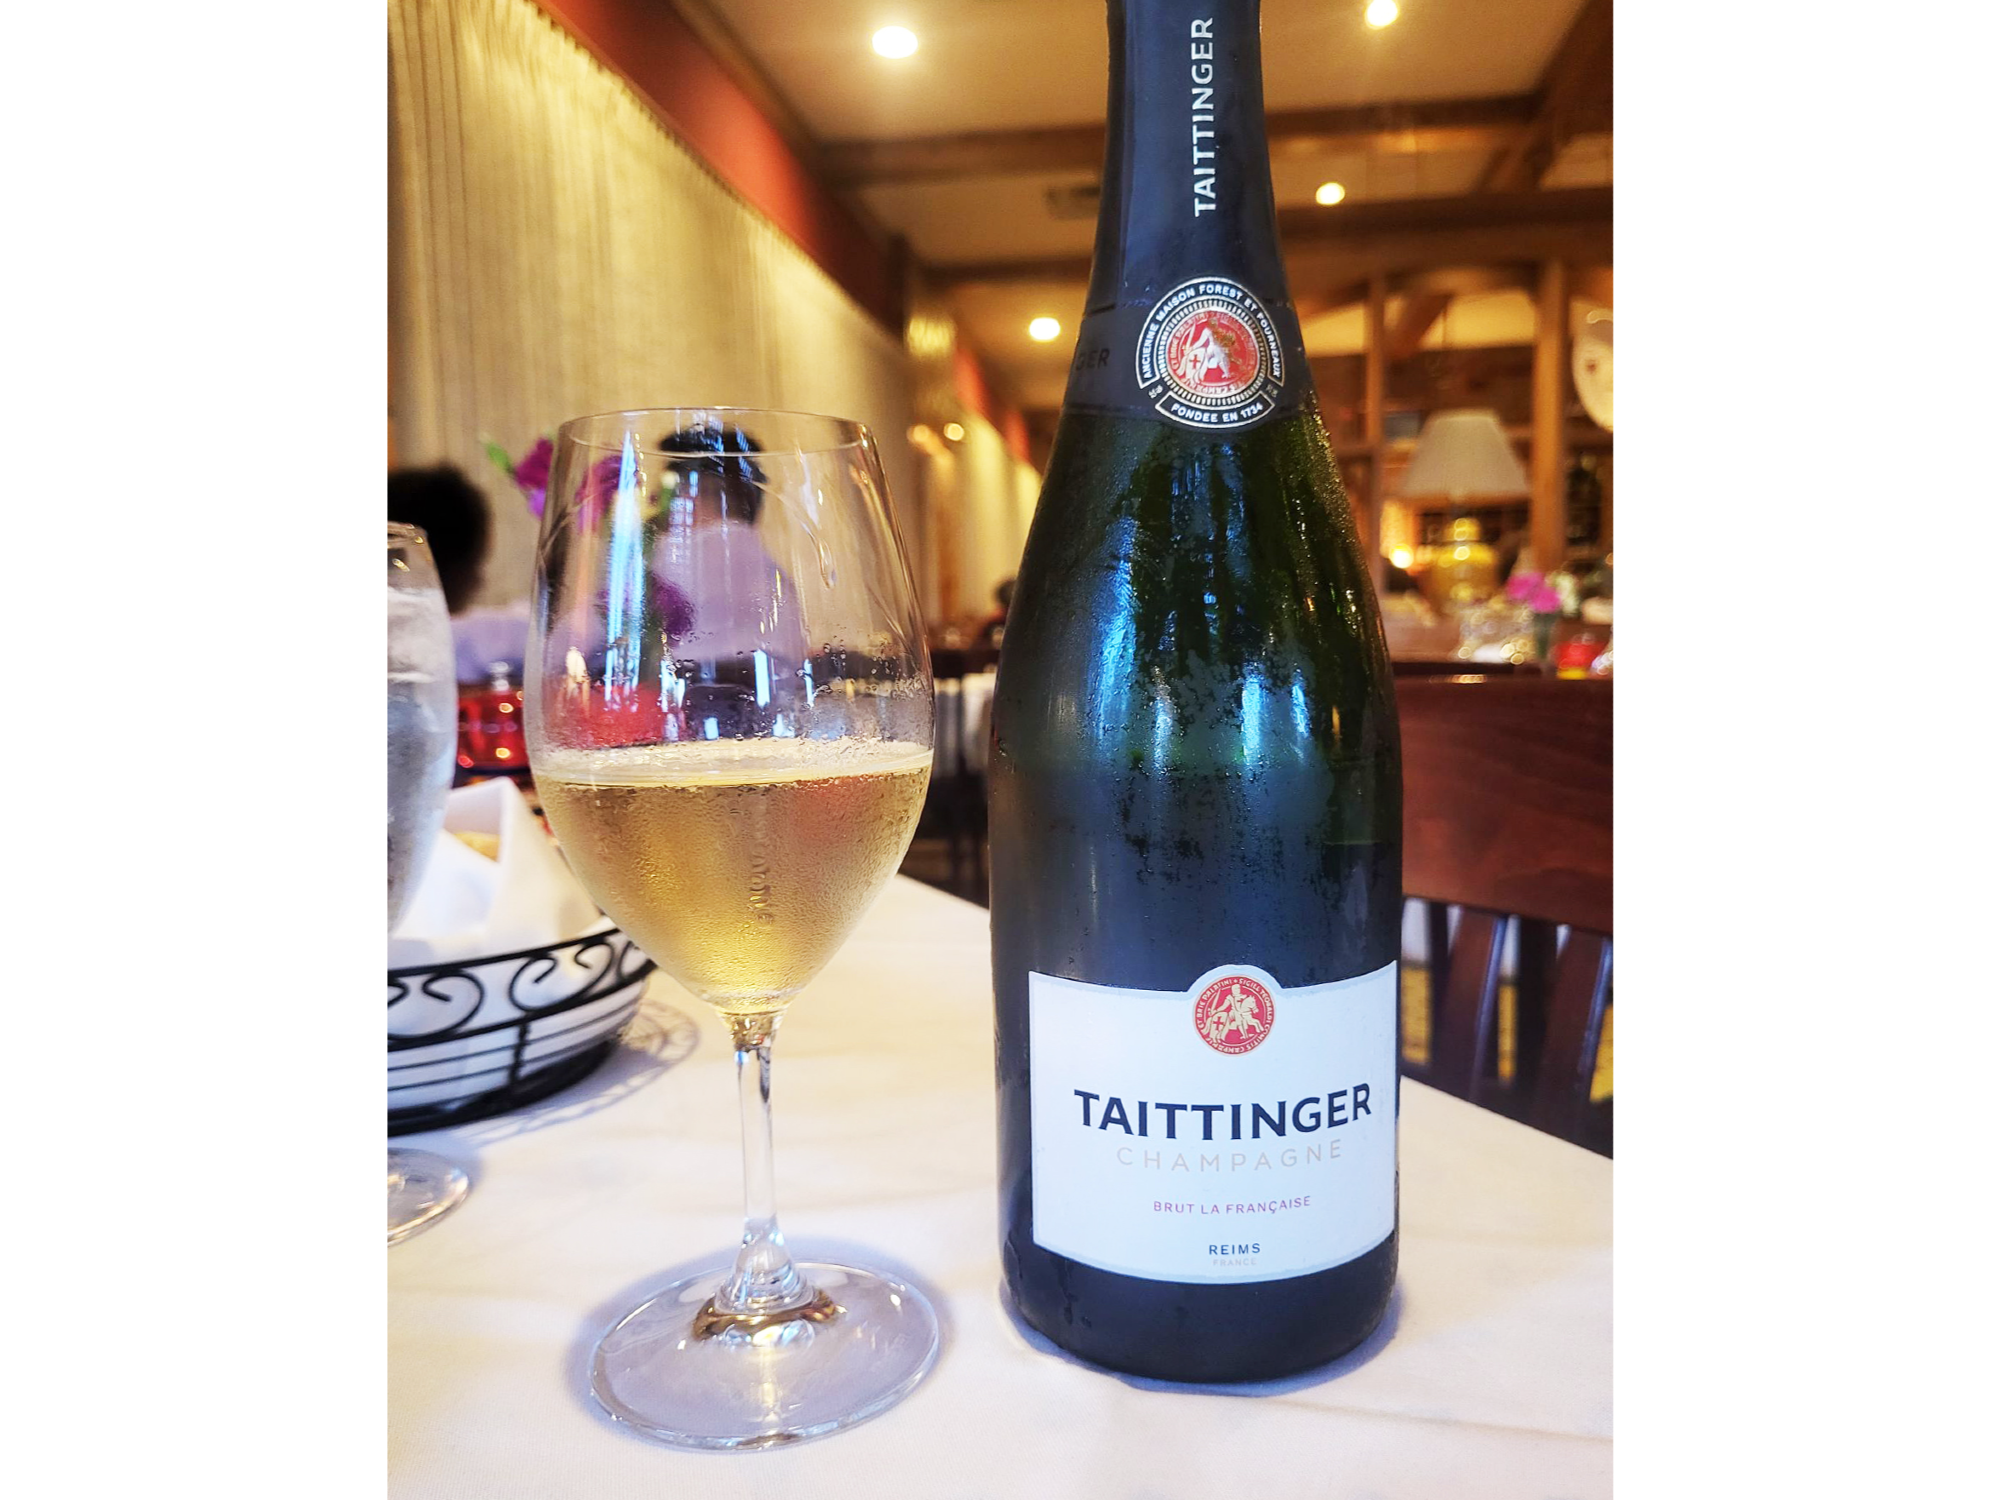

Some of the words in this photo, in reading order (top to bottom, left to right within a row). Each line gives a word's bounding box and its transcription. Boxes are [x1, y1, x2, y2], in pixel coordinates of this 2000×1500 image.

[1190, 17, 1216, 218] TAITTINGER
[1142, 323, 1160, 379] ANCIENNE
[1155, 286, 1195, 322] MAISON
[1199, 283, 1243, 300] FOREST
[1243, 297, 1258, 312] ET
[1256, 311, 1281, 378] FOURNEAUX
[1171, 402, 1219, 423] FONDEE
[1222, 412, 1239, 423] EN
[1240, 402, 1264, 419] 1734
[1074, 1083, 1372, 1141] TAITTINGER
[1116, 1139, 1342, 1173] CHAMPAGNE
[1153, 1200, 1195, 1214] BRUT
[1200, 1204, 1220, 1215] LA
[1225, 1195, 1311, 1215] FRANÇAISE
[1208, 1242, 1261, 1256] REIMS
[1212, 1257, 1257, 1267] FRANCE
